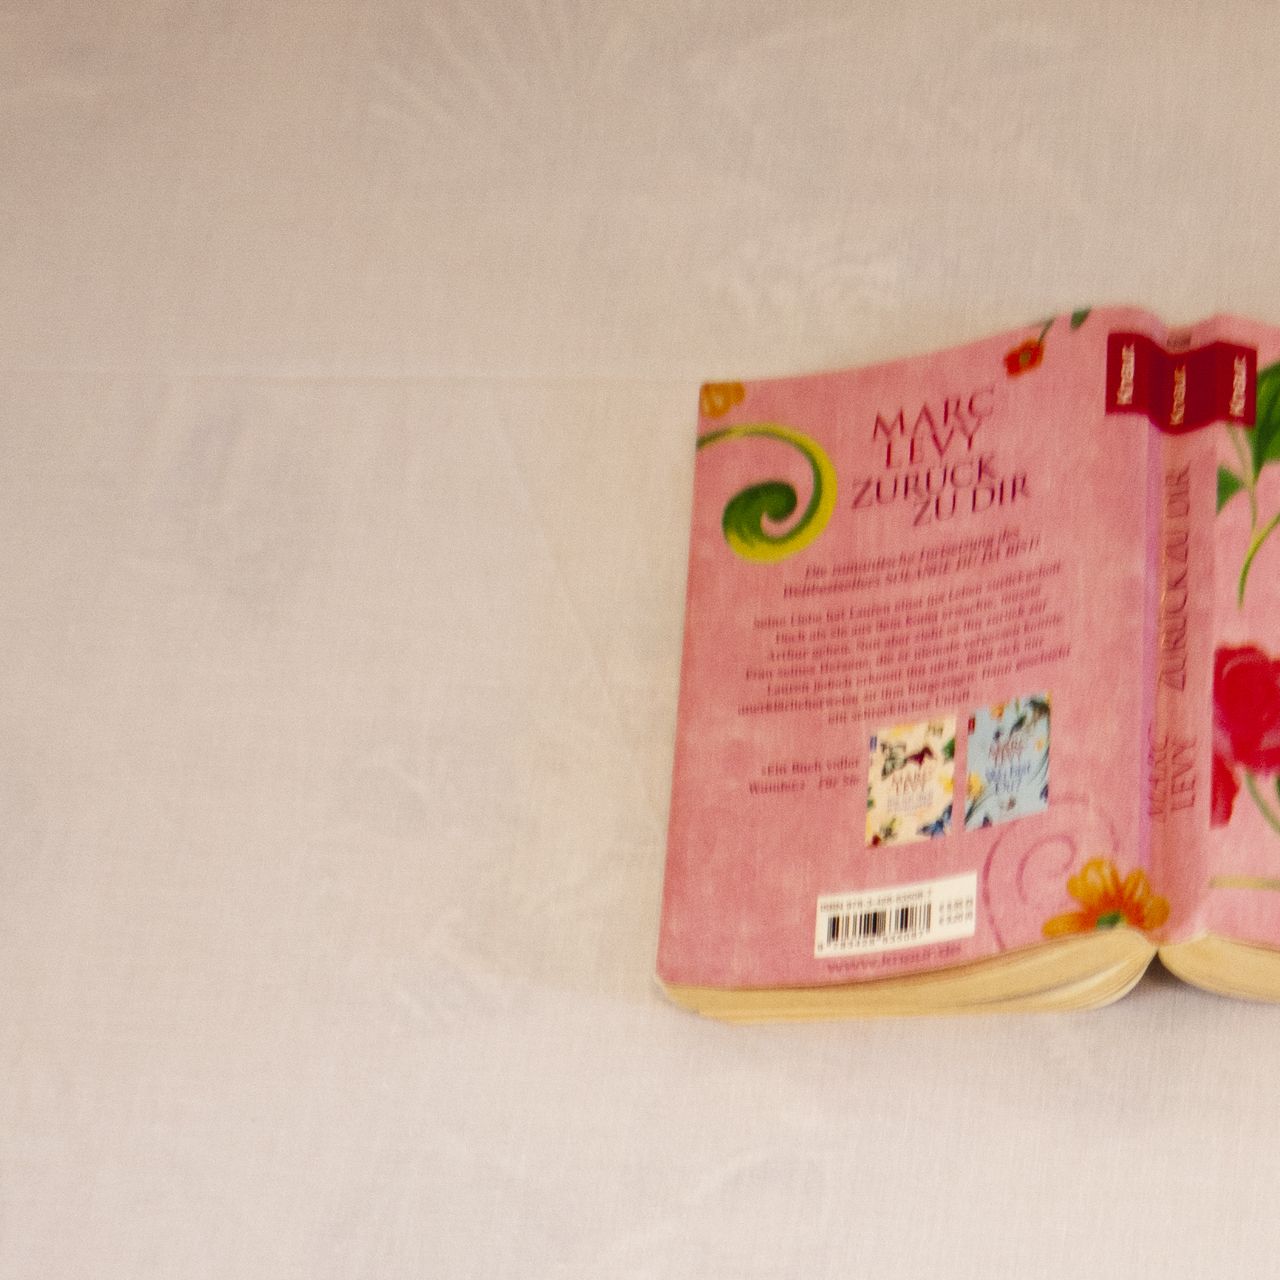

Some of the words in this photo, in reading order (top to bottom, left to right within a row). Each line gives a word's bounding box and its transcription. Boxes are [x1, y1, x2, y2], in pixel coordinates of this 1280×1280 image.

[873, 384, 995, 441] MARC
[887, 415, 983, 469] LEVY
[913, 490, 957, 526] ZU
[972, 472, 1030, 513] DIR
